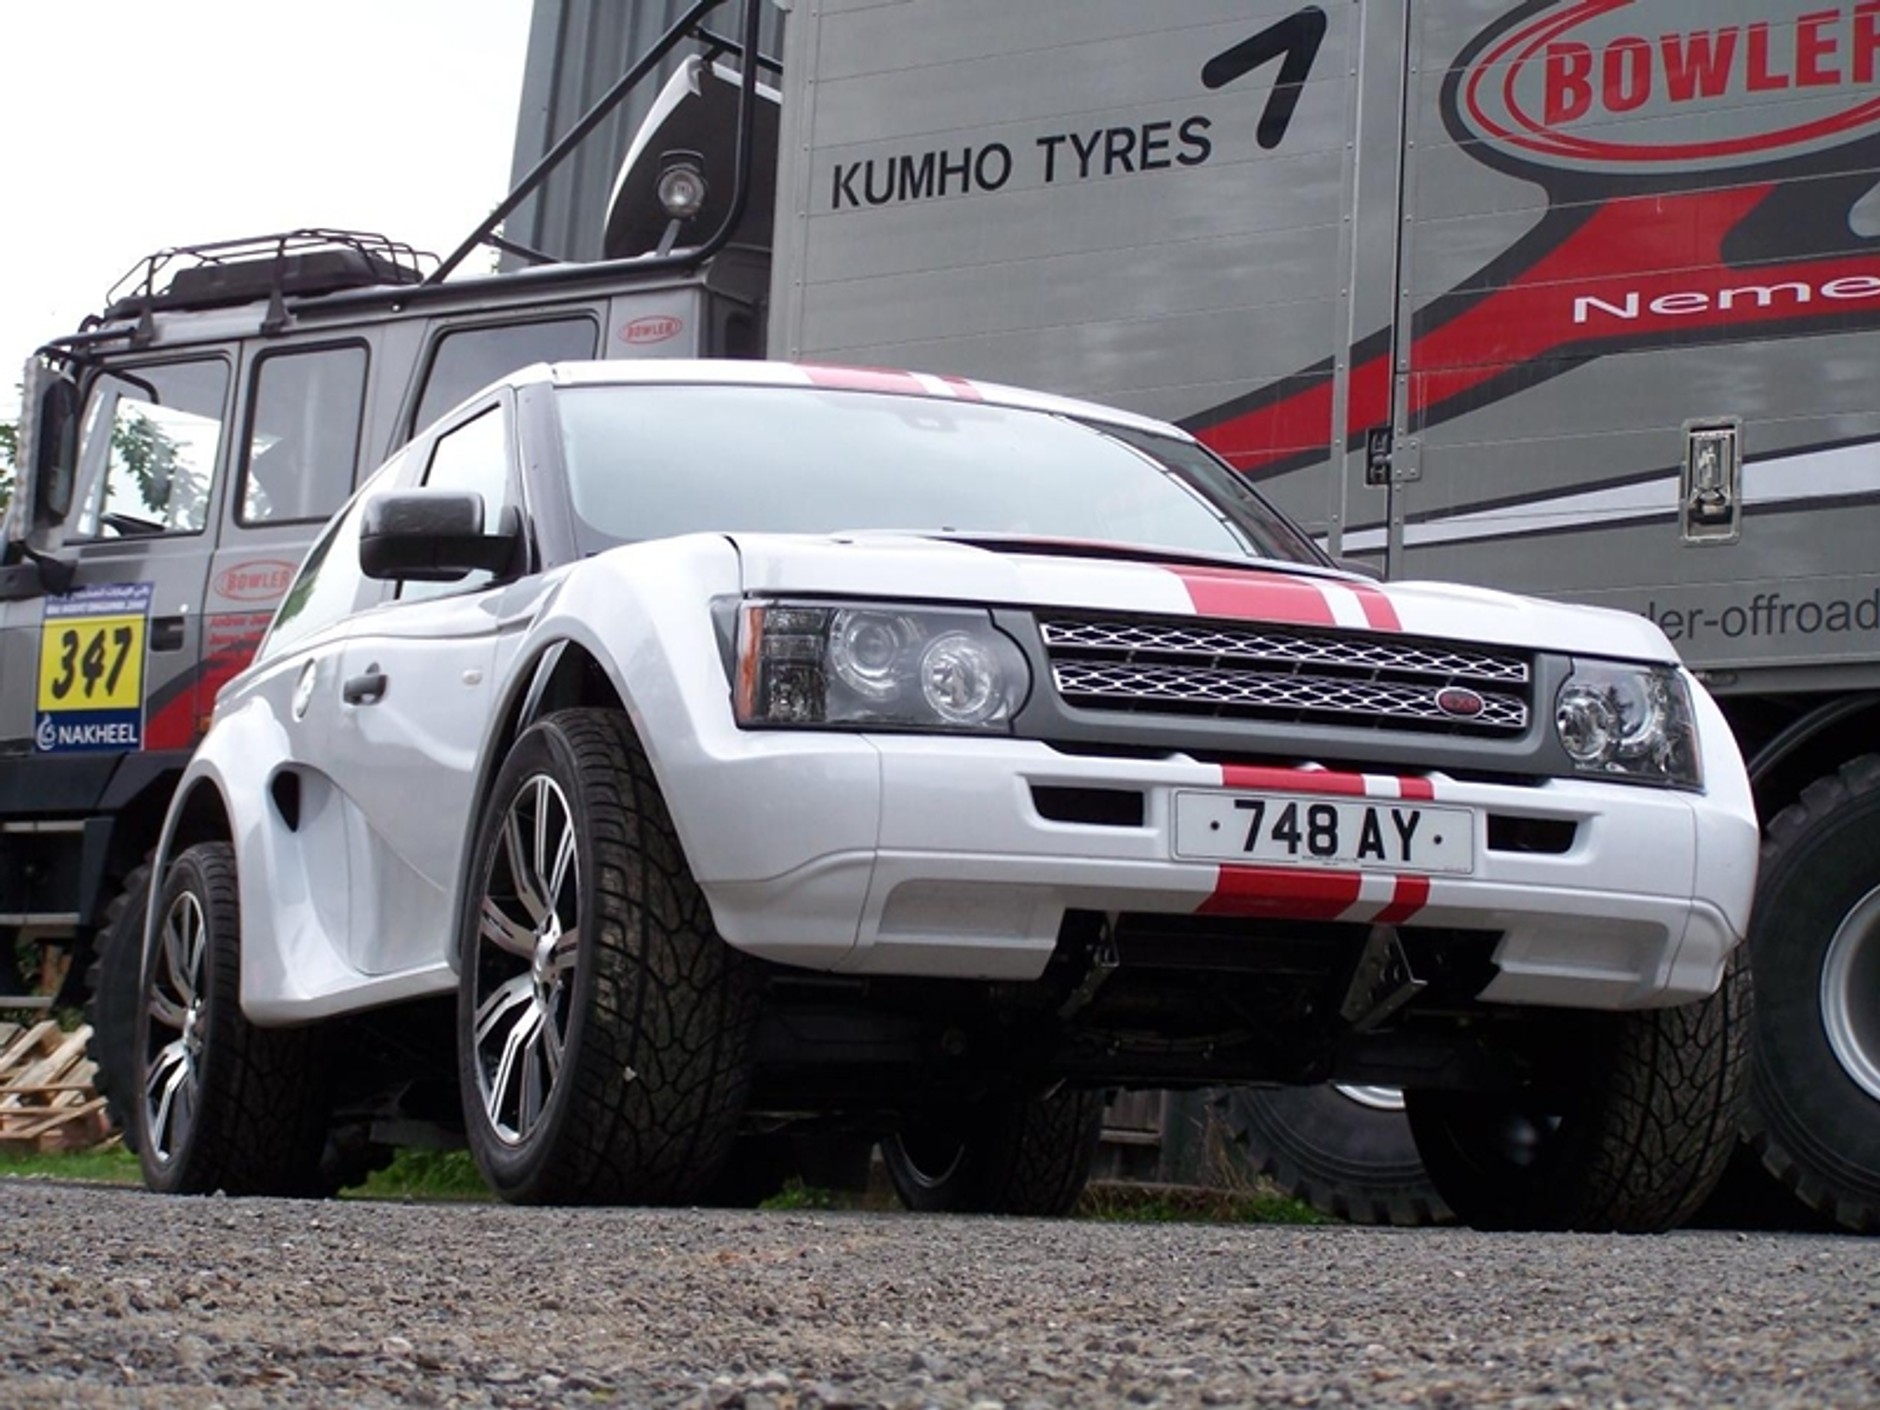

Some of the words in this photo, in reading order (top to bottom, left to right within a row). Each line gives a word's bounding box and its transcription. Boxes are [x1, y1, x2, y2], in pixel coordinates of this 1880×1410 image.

[831, 142, 1012, 209] KUMHO
[1036, 115, 1212, 183] TYRES
[1574, 276, 1880, 323] Neme
[226, 569, 290, 593] BOWLER
[1641, 589, 1880, 642] ler-offroad
[52, 625, 133, 700] 347
[59, 723, 138, 744] NAKHEEL
[1233, 799, 1338, 857] 748
[1357, 806, 1420, 861] AY
